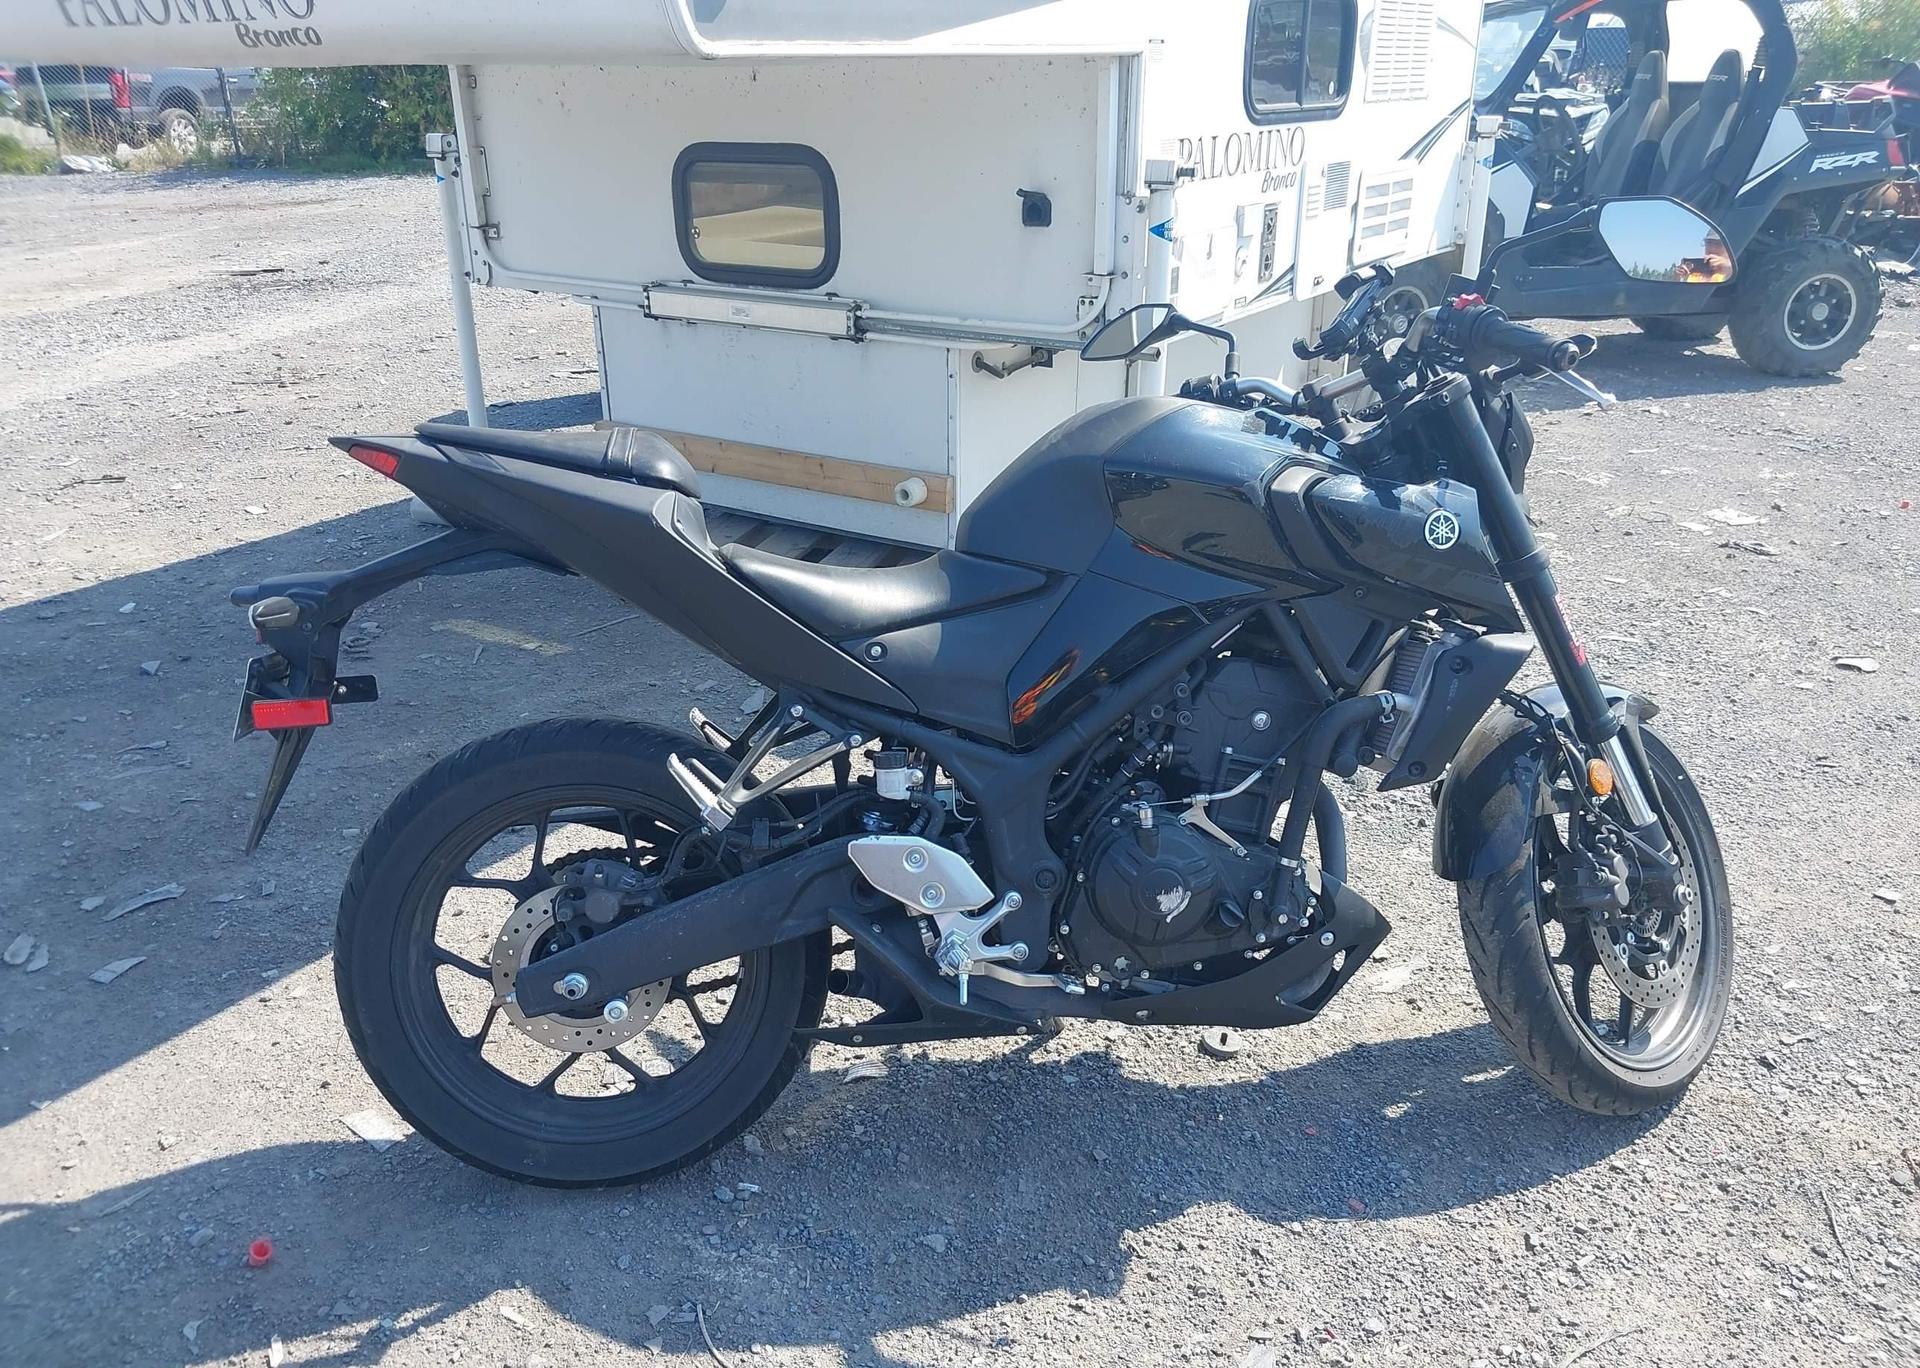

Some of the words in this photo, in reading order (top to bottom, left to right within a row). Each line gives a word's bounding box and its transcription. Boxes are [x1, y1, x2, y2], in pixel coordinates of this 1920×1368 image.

[234, 21, 323, 48] Bronco
[1177, 126, 1305, 181] PALOMINO
[1808, 150, 1880, 173] RZR
[1261, 172, 1297, 193] Bronco
